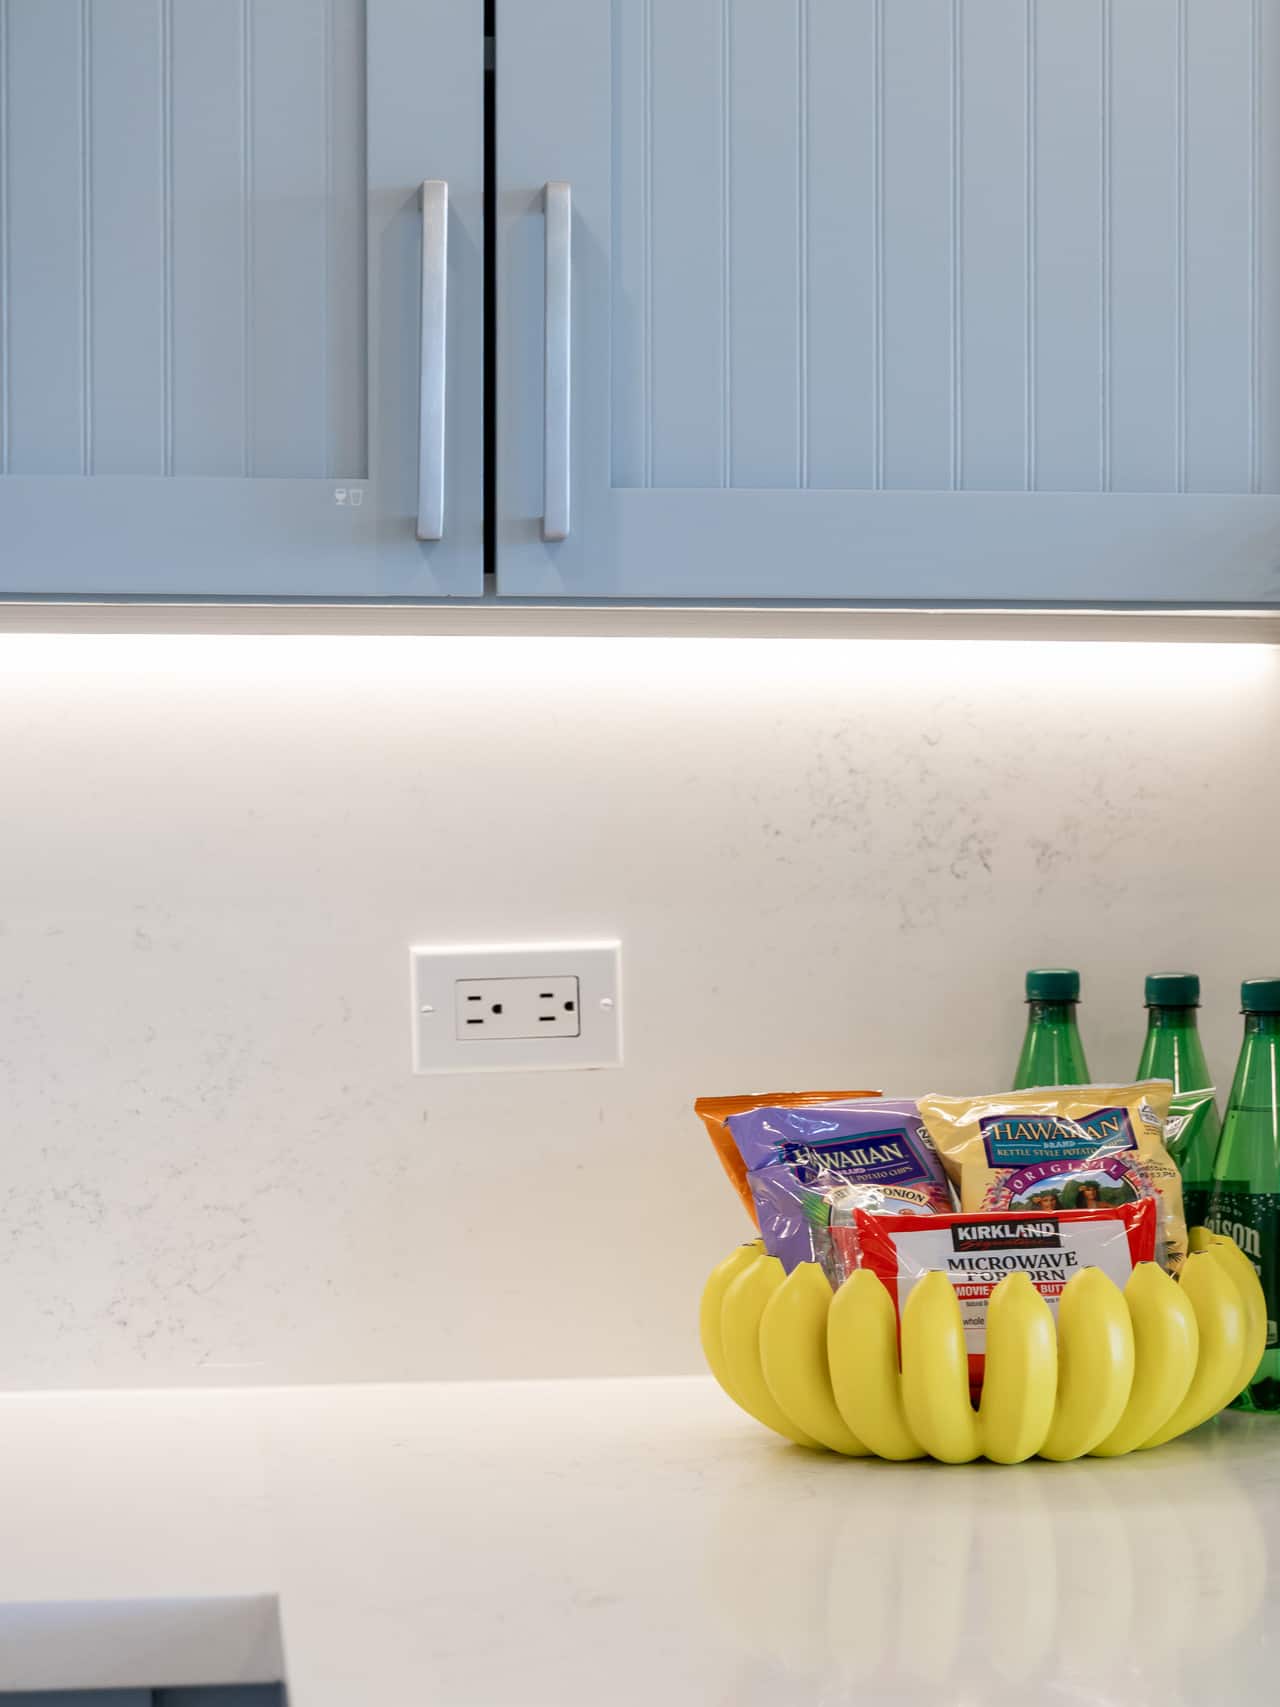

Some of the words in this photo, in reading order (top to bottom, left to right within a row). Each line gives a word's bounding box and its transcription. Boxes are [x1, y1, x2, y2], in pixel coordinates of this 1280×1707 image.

[997, 1148, 1031, 1157] KETTLE
[1032, 1148, 1061, 1157] STYLE
[1063, 1146, 1098, 1157] POTATO
[883, 1187, 925, 1204] ONION
[957, 1222, 1055, 1240] KIRKLAND
[1204, 1213, 1262, 1258] aison
[947, 1251, 1078, 1271] MICROWAVE
[967, 1270, 1066, 1281] POPORN
[956, 1285, 989, 1297] MOVIE
[963, 1316, 985, 1326] whole
